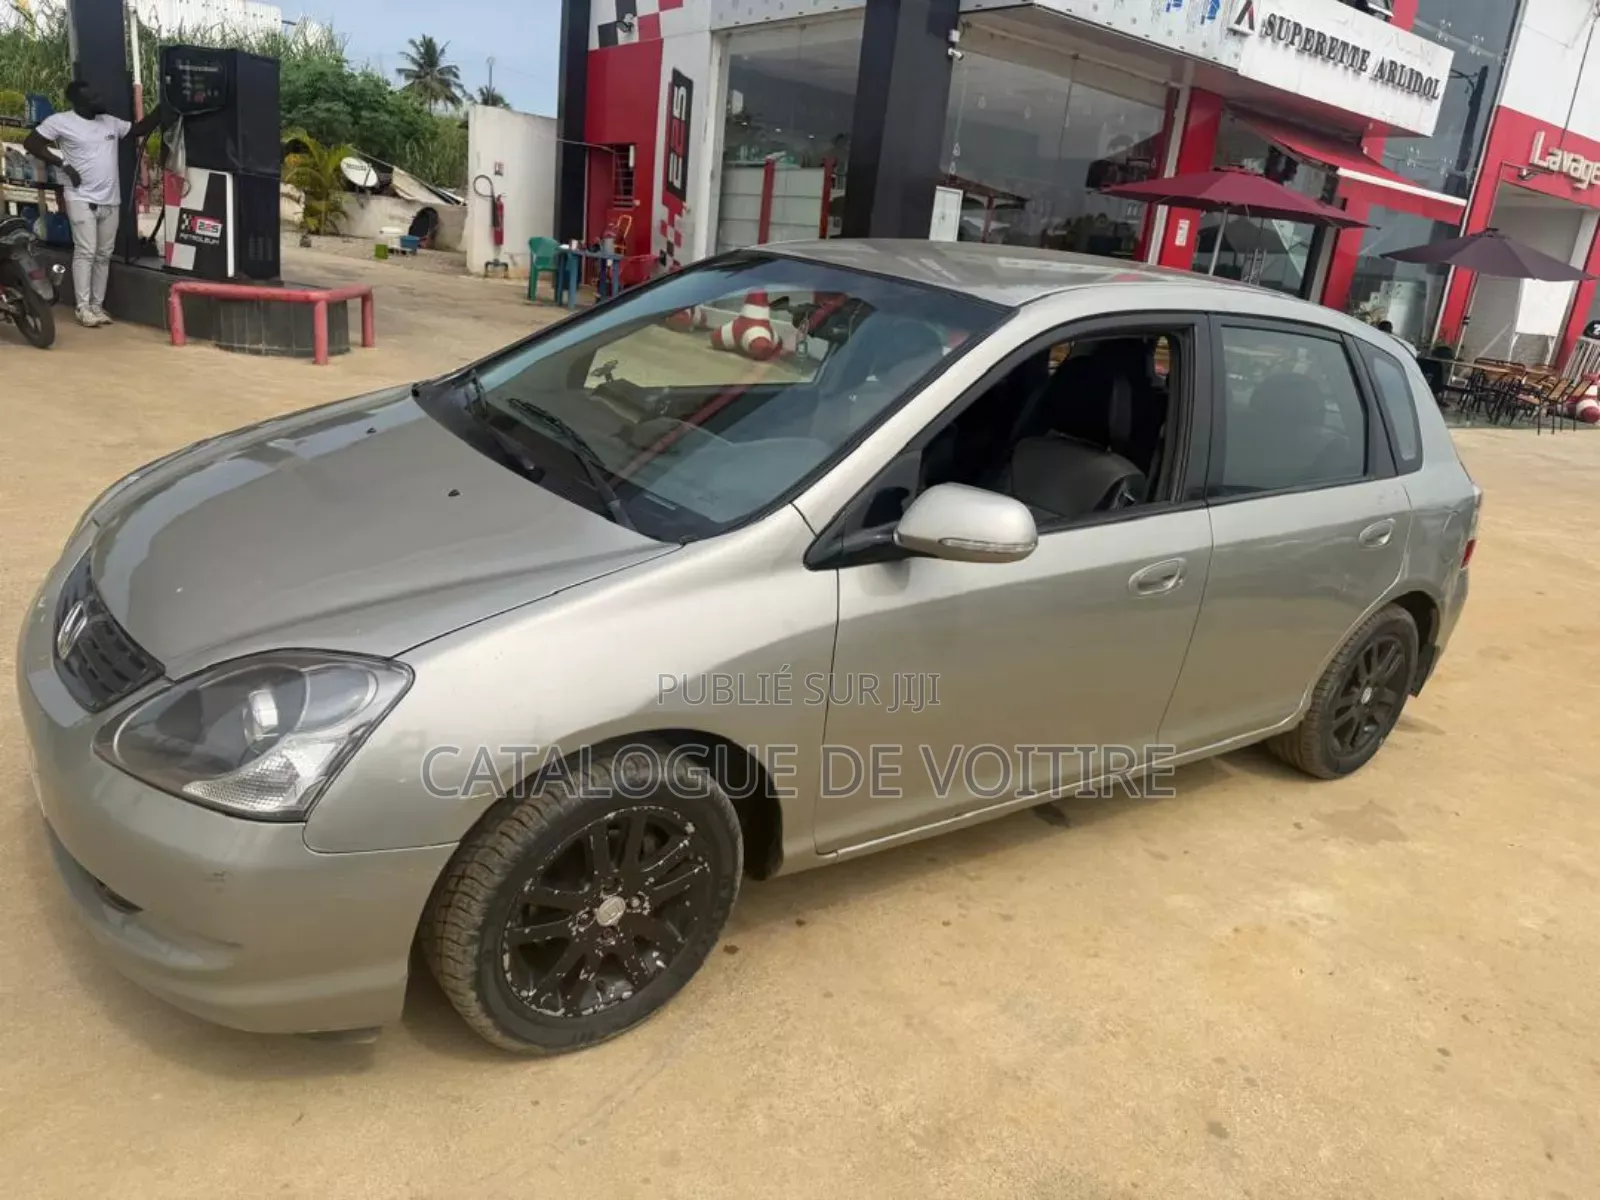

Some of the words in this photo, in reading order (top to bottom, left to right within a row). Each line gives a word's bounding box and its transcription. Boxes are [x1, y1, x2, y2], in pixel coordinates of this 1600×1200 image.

[1264, 13, 1371, 73] SUPERETTE
[1374, 56, 1441, 100] ARLIDOL
[1529, 130, 1600, 190] Lavage
